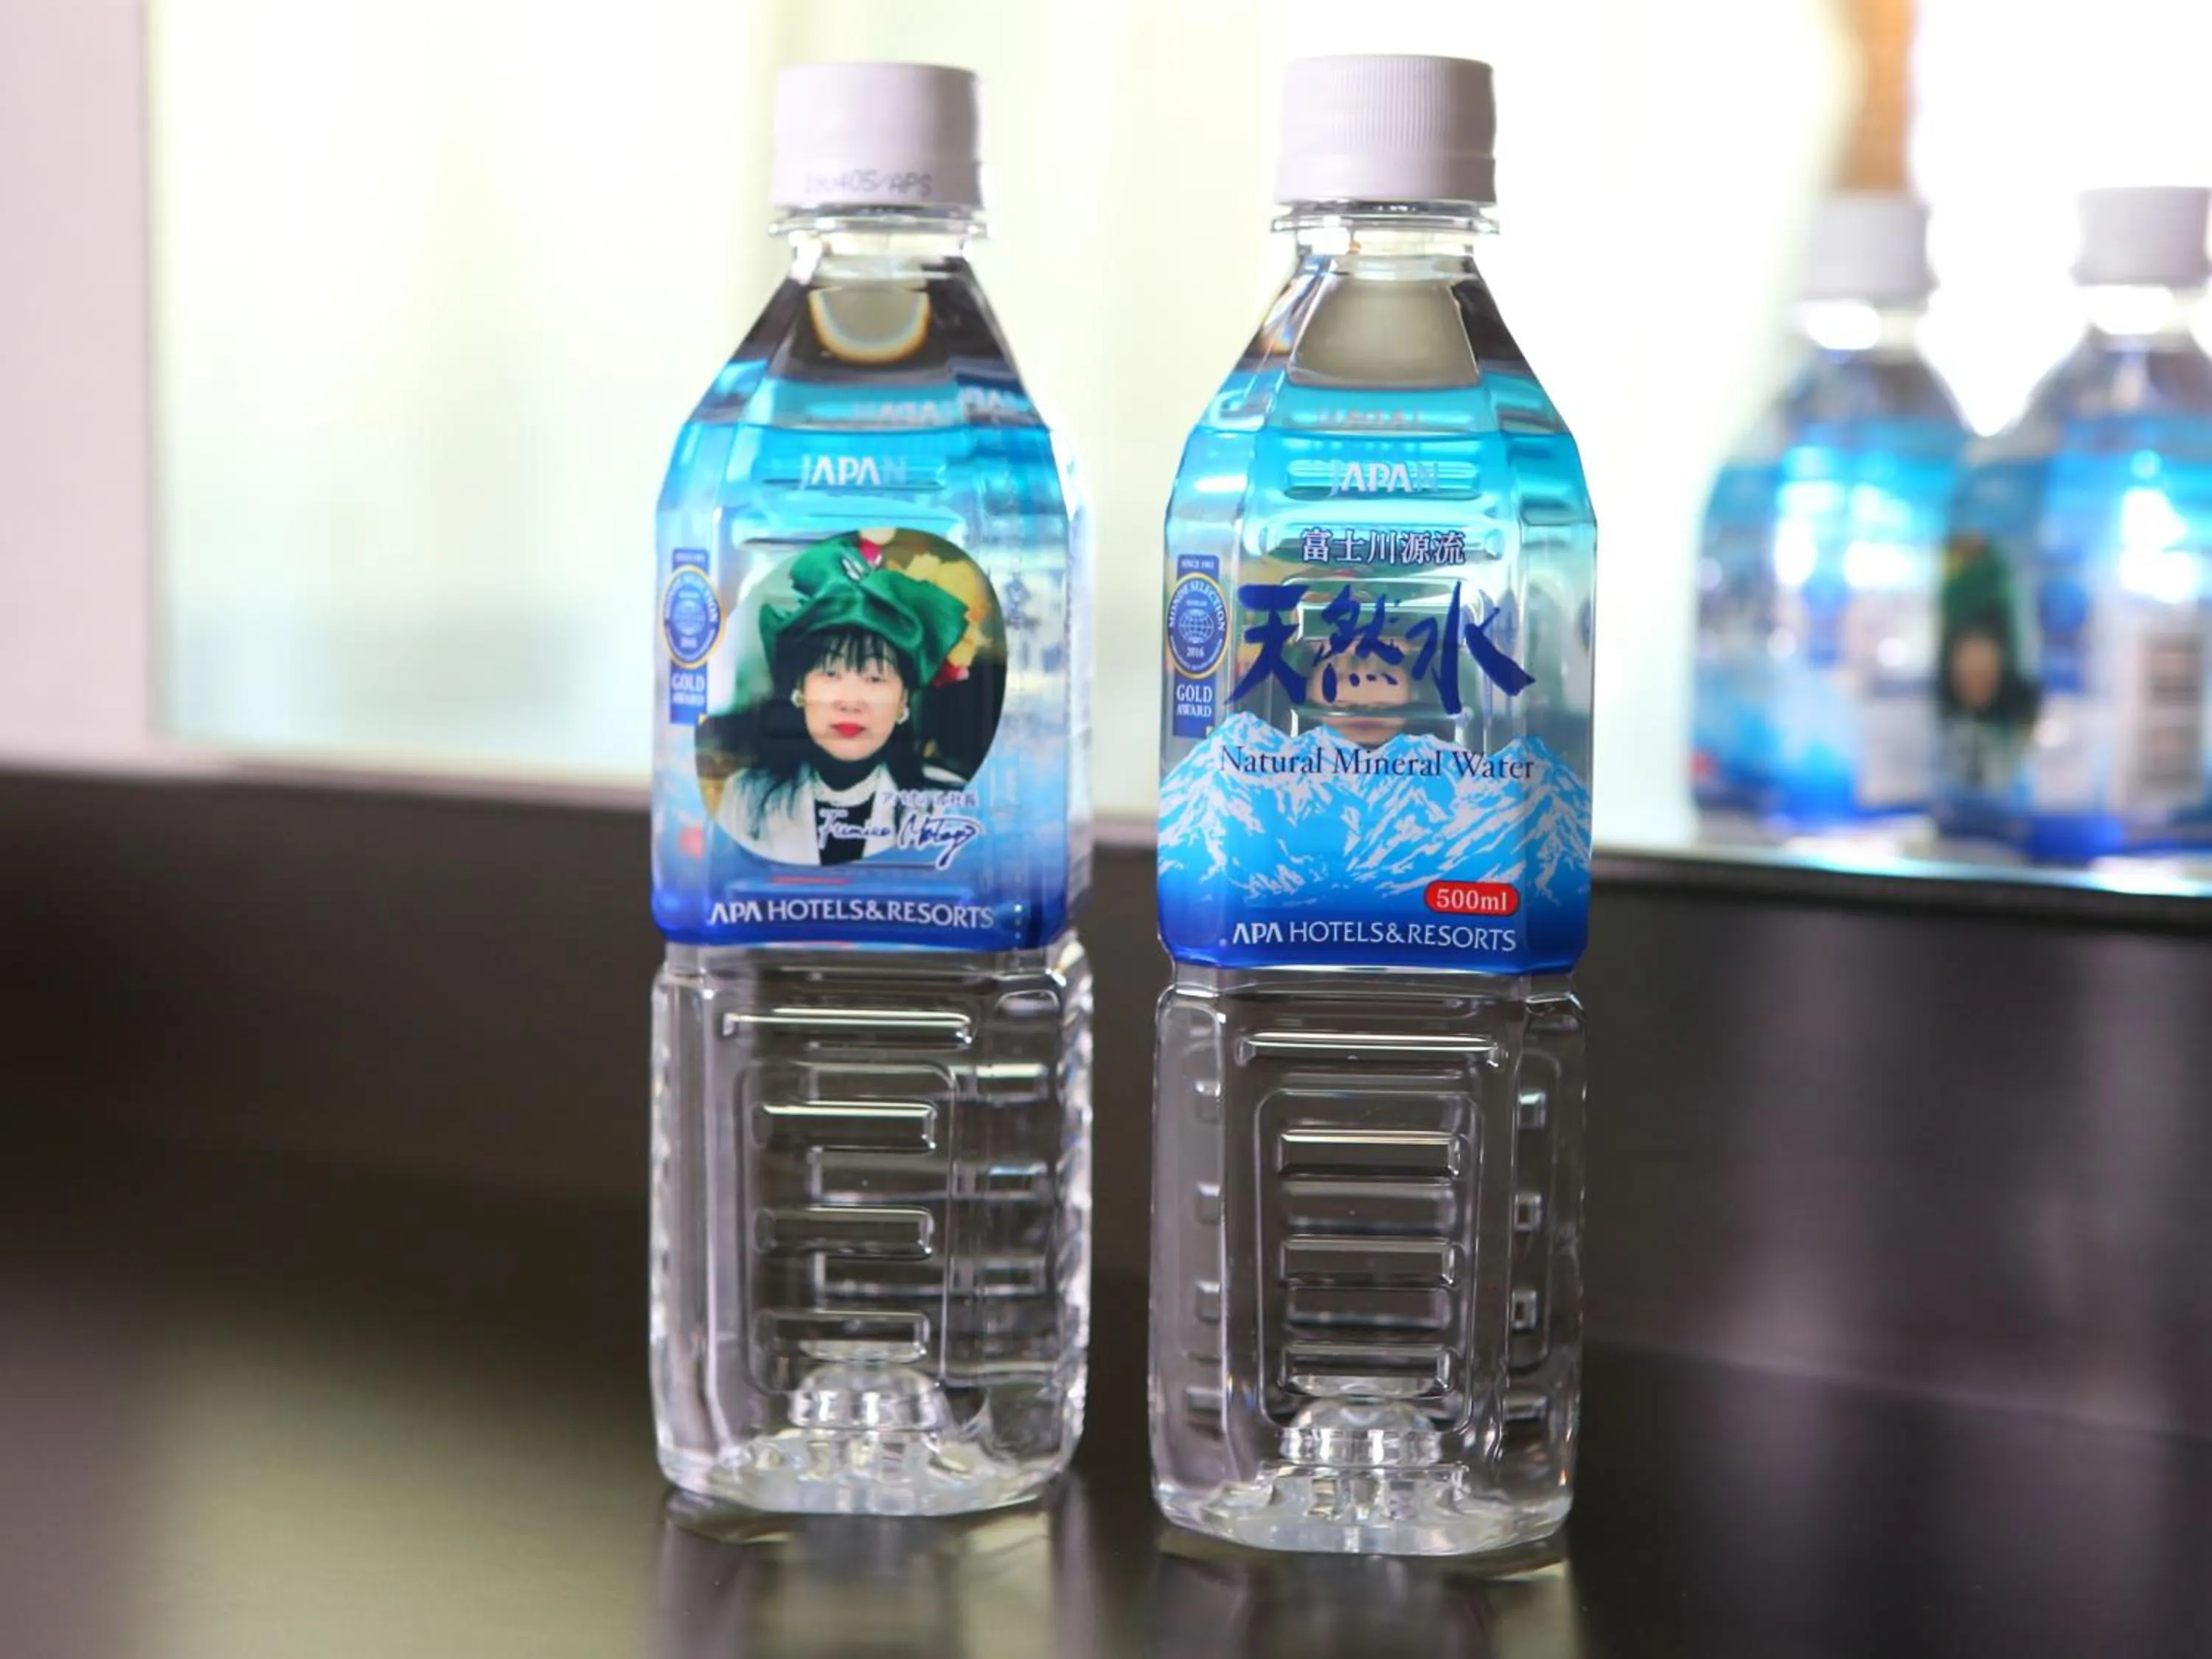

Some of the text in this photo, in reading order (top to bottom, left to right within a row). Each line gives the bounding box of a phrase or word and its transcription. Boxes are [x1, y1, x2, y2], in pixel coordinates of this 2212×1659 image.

[799, 453, 907, 491] JAPAN
[1329, 459, 1439, 496] JAPAN
[1301, 526, 1466, 566] 富士川源流
[1224, 580, 1536, 714] 天然水
[671, 672, 706, 692] GOLD
[1176, 683, 1213, 703] GOLD
[1176, 703, 1212, 718] AWARD
[1220, 744, 1535, 780] Natural Mineral Water
[708, 898, 995, 930] APA HOTELS&RESORTS
[1435, 888, 1508, 912] 500ml
[1231, 920, 1517, 953] APA HOTELS&RESORTS
